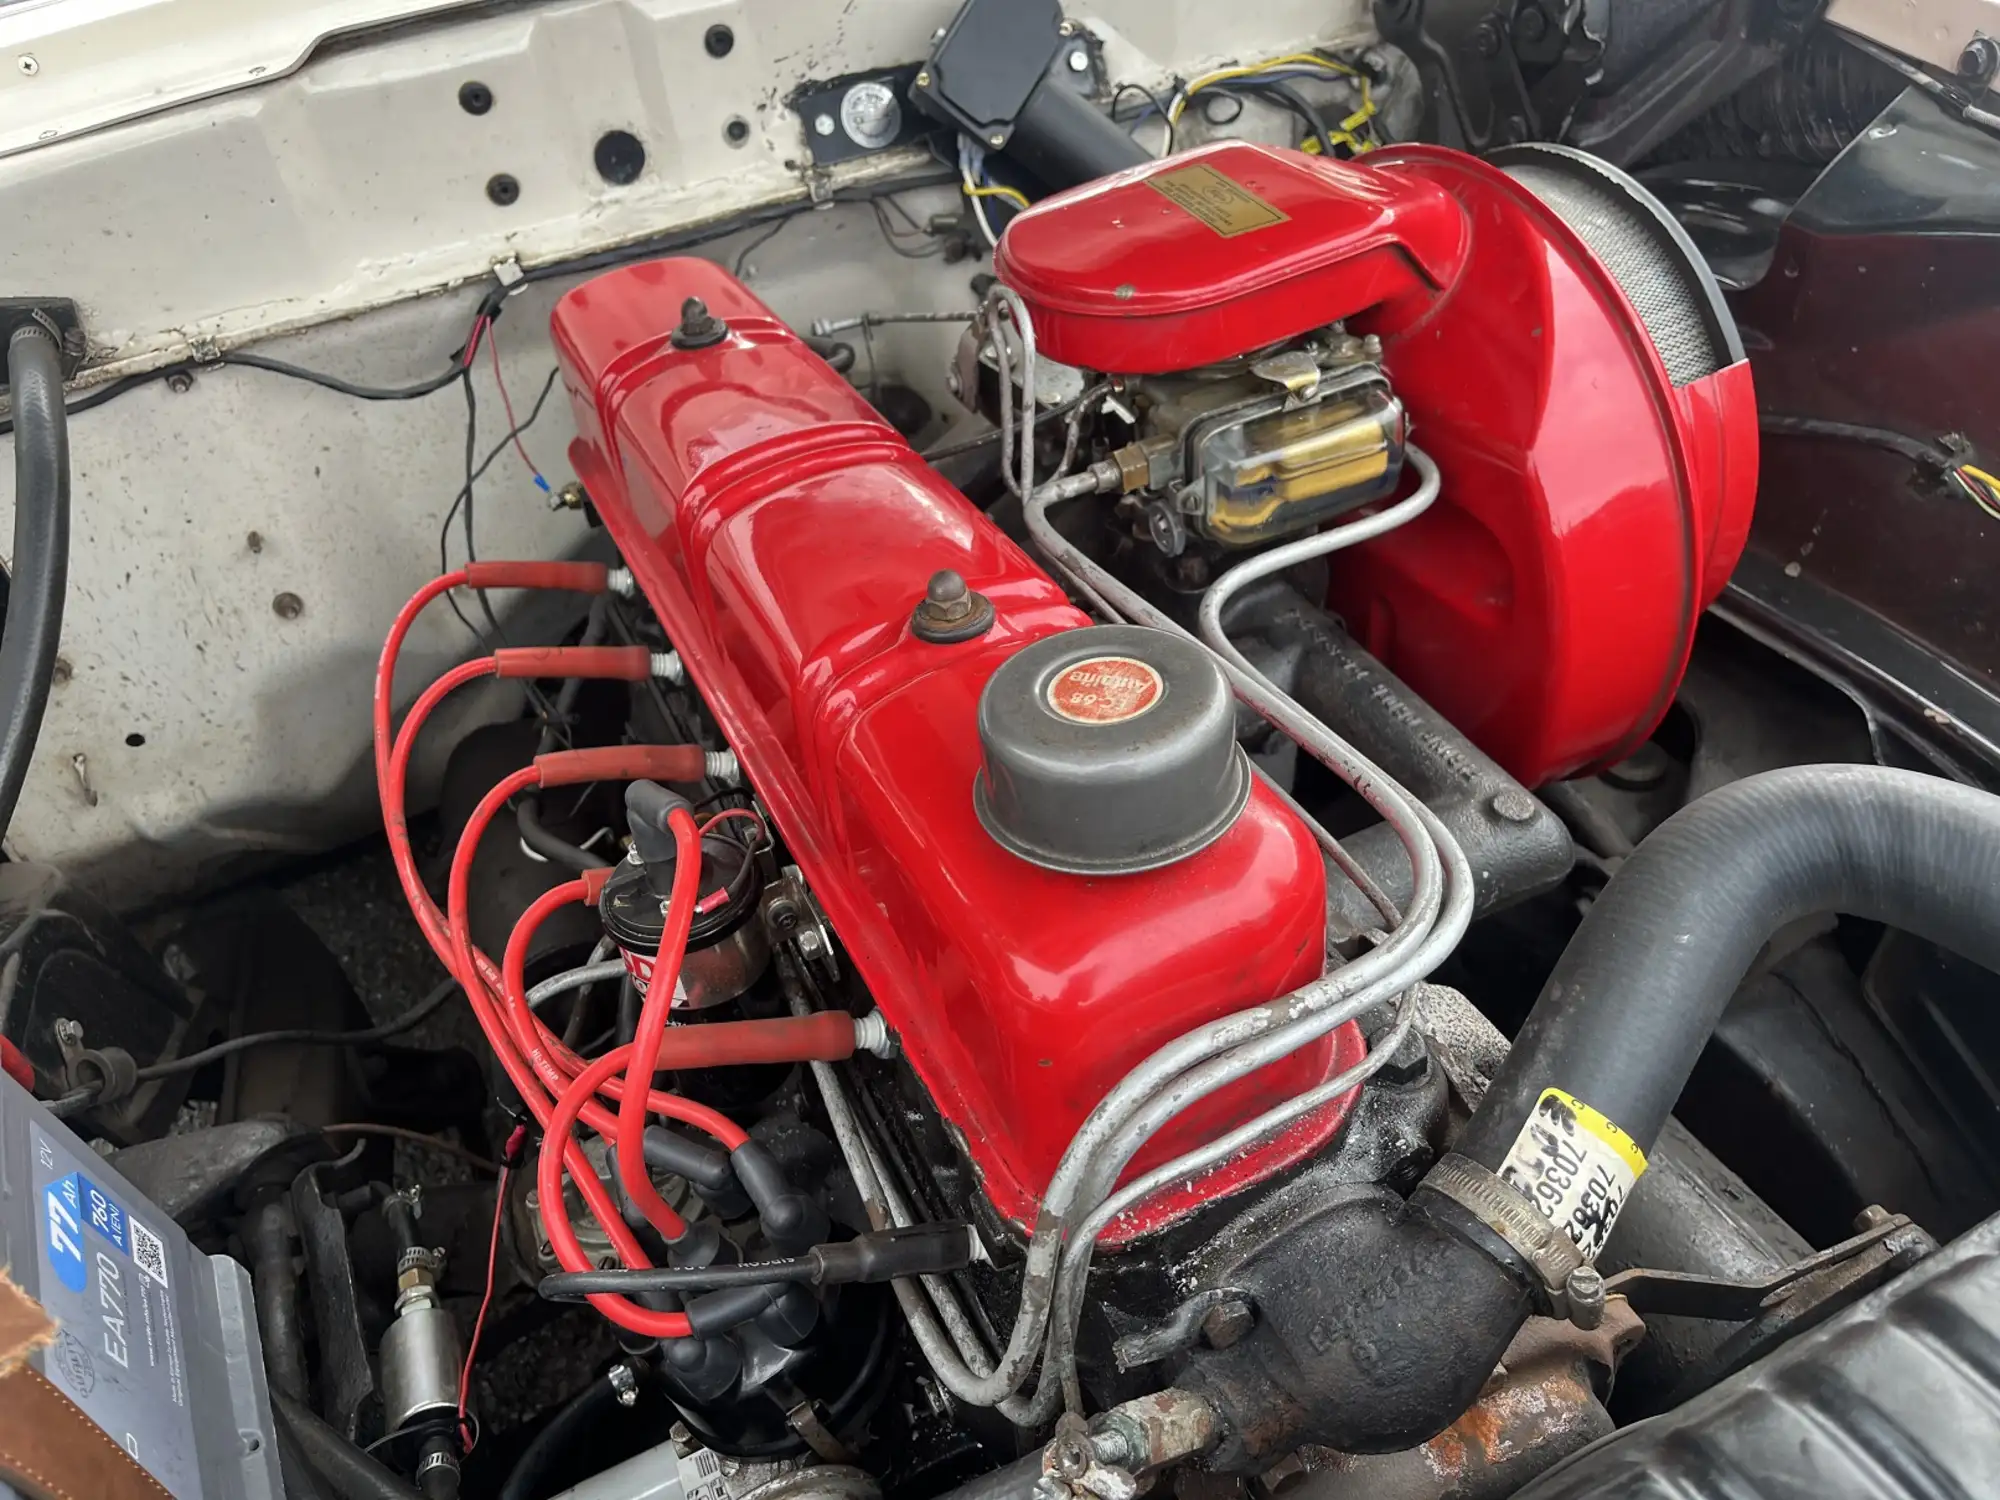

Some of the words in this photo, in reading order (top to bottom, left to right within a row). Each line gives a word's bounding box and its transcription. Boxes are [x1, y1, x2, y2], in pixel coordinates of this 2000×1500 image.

[40, 1137, 53, 1170] 12V
[1536, 1140, 1588, 1219] 70362
[61, 1179, 77, 1209] Ah
[90, 1189, 109, 1233] 760
[47, 1191, 82, 1262] 77
[96, 1252, 129, 1368] EA770
